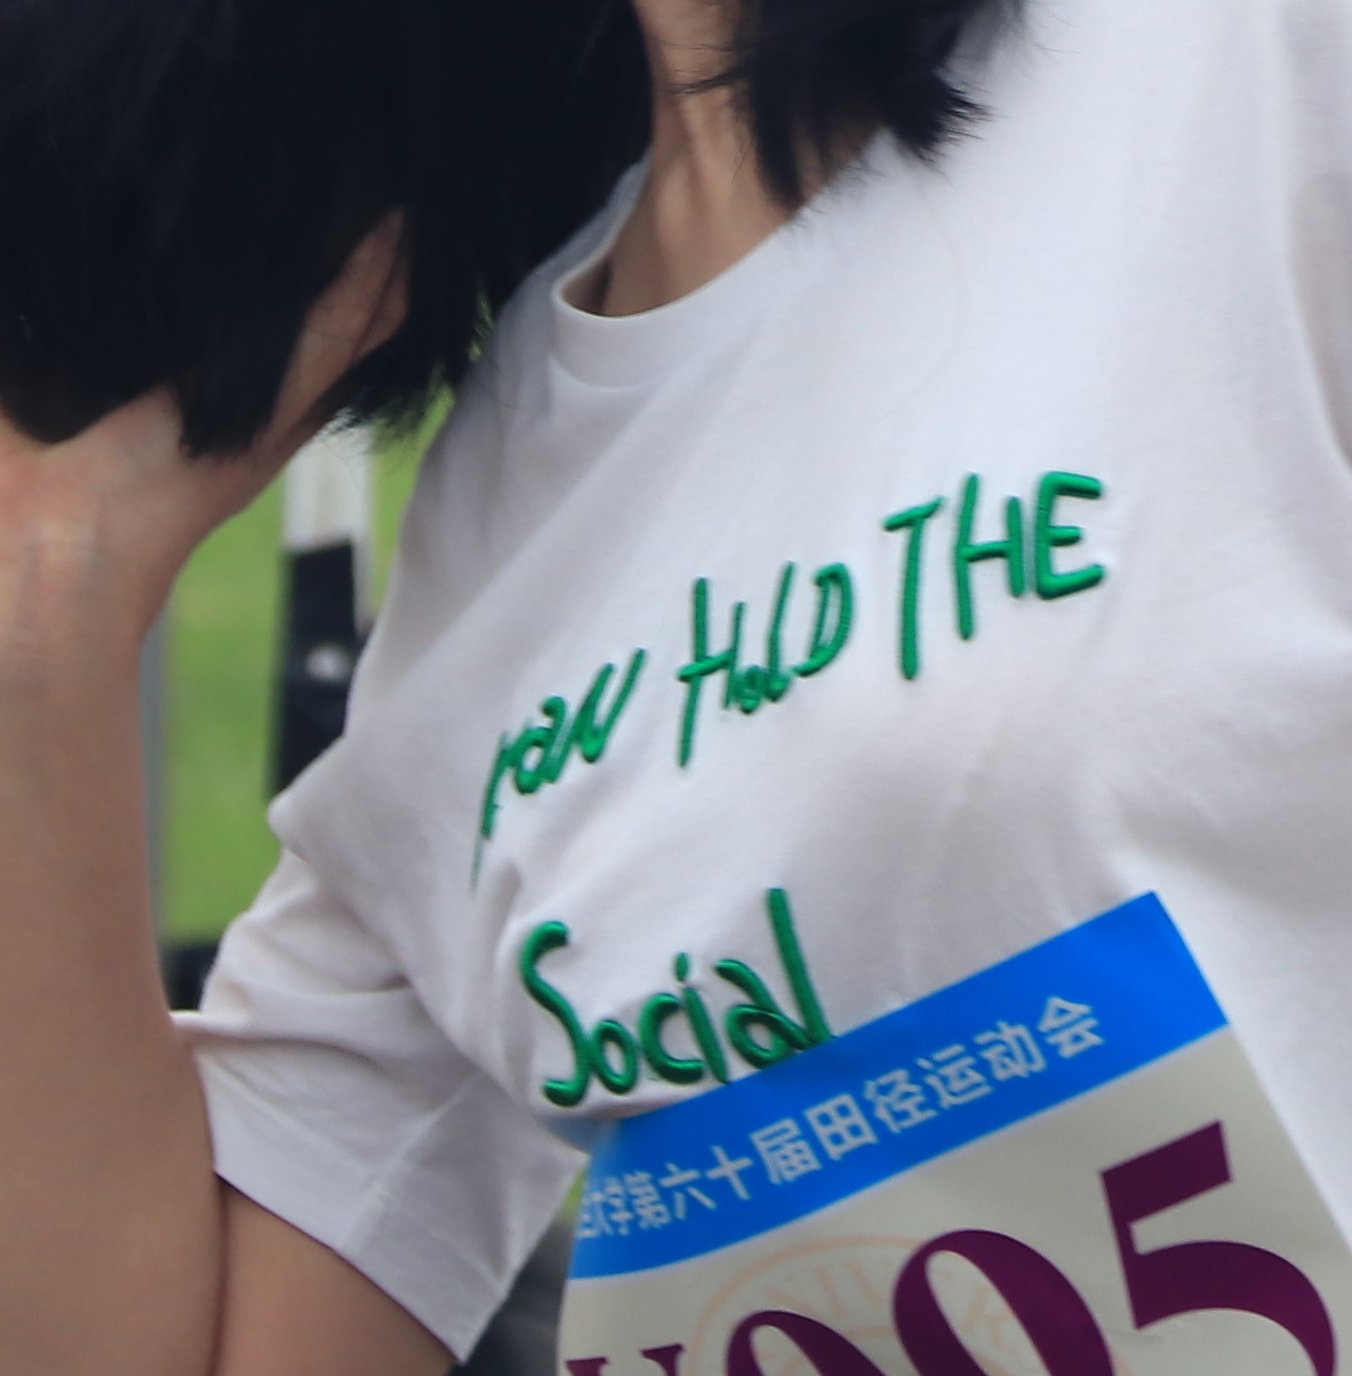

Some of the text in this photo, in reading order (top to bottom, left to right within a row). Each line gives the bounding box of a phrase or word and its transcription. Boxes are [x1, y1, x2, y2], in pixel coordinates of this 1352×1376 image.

[880, 470, 1105, 682] THE
[517, 887, 832, 1106] Social
[565, 1120, 1339, 1376] 05
